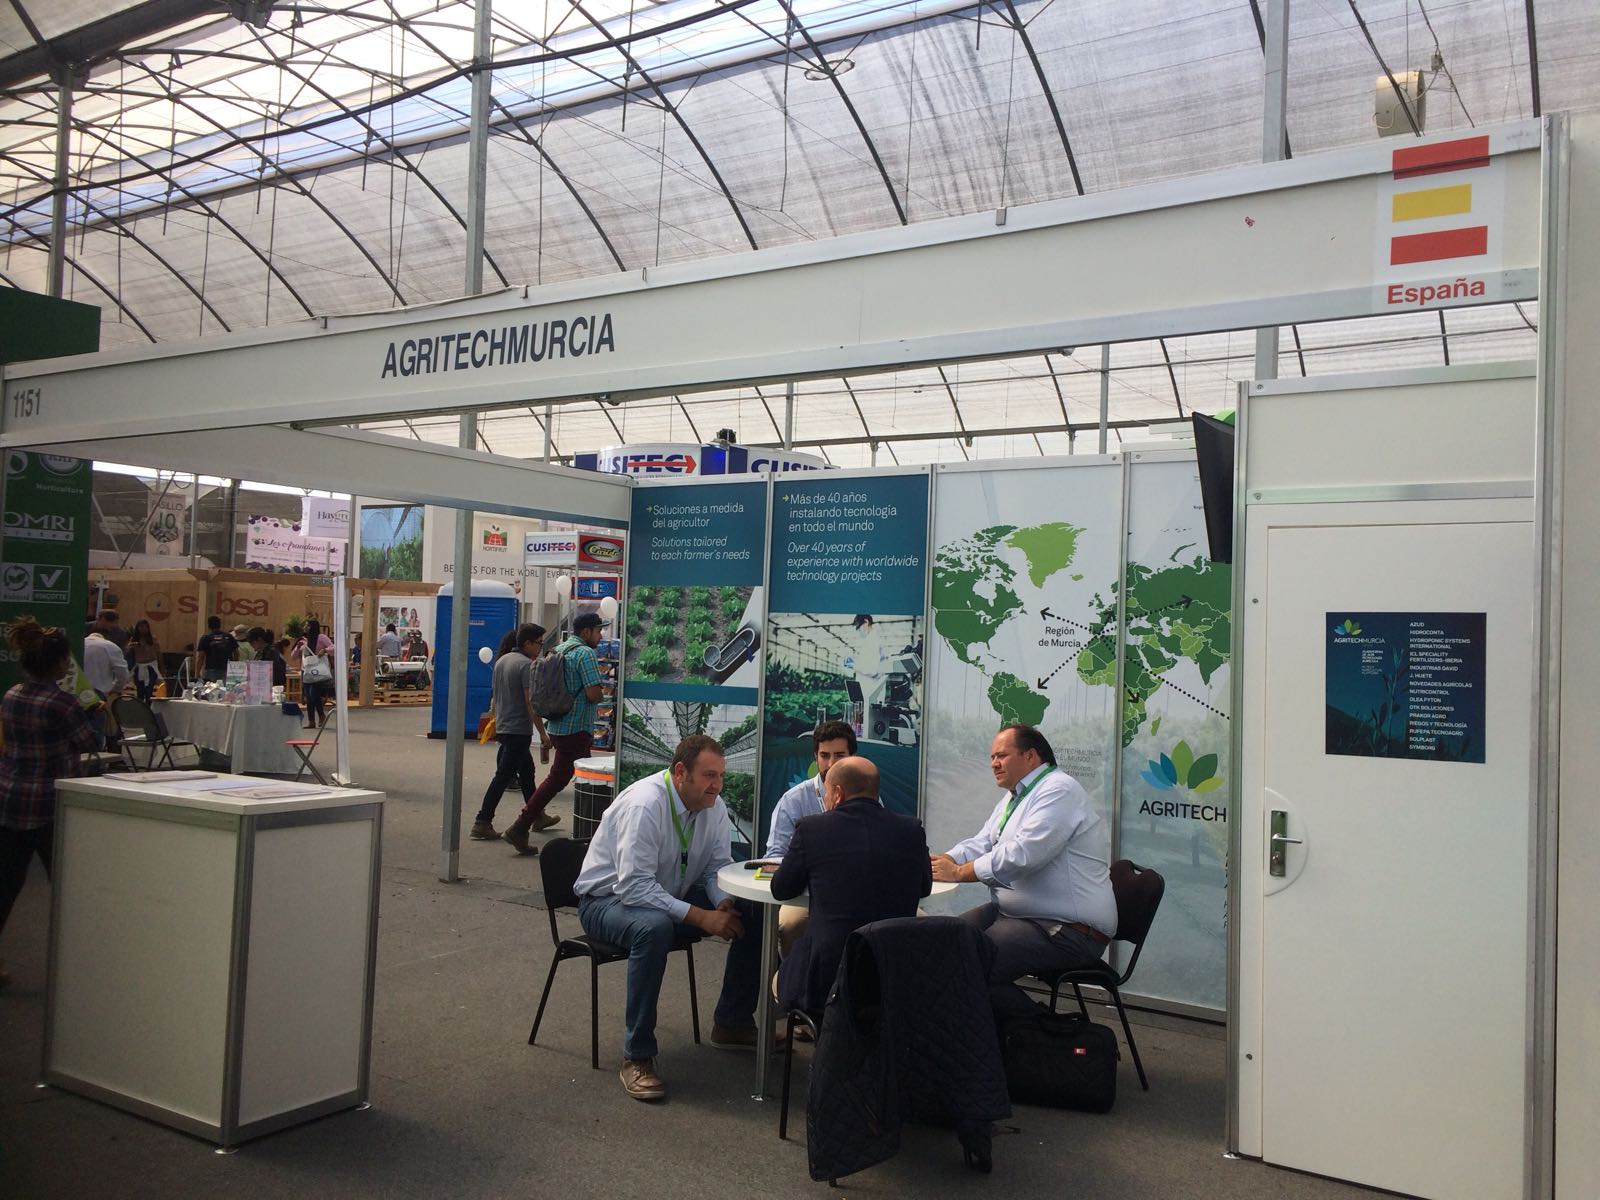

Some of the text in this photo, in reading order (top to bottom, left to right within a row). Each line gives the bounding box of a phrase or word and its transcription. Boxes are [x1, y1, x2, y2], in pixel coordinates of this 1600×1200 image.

[1387, 278, 1485, 305] España
[381, 313, 615, 378] AGRITECHMURCIA
[13, 388, 41, 418] 1151
[790, 492, 867, 505] Más de 40 años
[653, 504, 700, 515] Soluciones
[709, 502, 744, 513] medida
[789, 504, 897, 519] instalando tecnología
[4, 511, 75, 532] OMRI
[652, 517, 710, 530] del agricultor
[788, 520, 874, 532] en todo el mundo
[526, 543, 572, 552] CUSITEC
[652, 536, 728, 547] Solutions tailored
[787, 541, 867, 555] Over 40 years of
[651, 551, 660, 560] to
[661, 550, 682, 560] each
[722, 549, 750, 560] needs
[787, 555, 919, 569] experience with worldwide
[480, 566, 497, 576] FOR
[499, 568, 515, 577] THE
[517, 569, 540, 578] WORL
[786, 570, 882, 584] technology projects
[177, 591, 269, 617] sbsa
[1045, 626, 1075, 637] Región
[1038, 638, 1081, 648] de Murcia
[1138, 800, 1227, 823] AGRITECH
